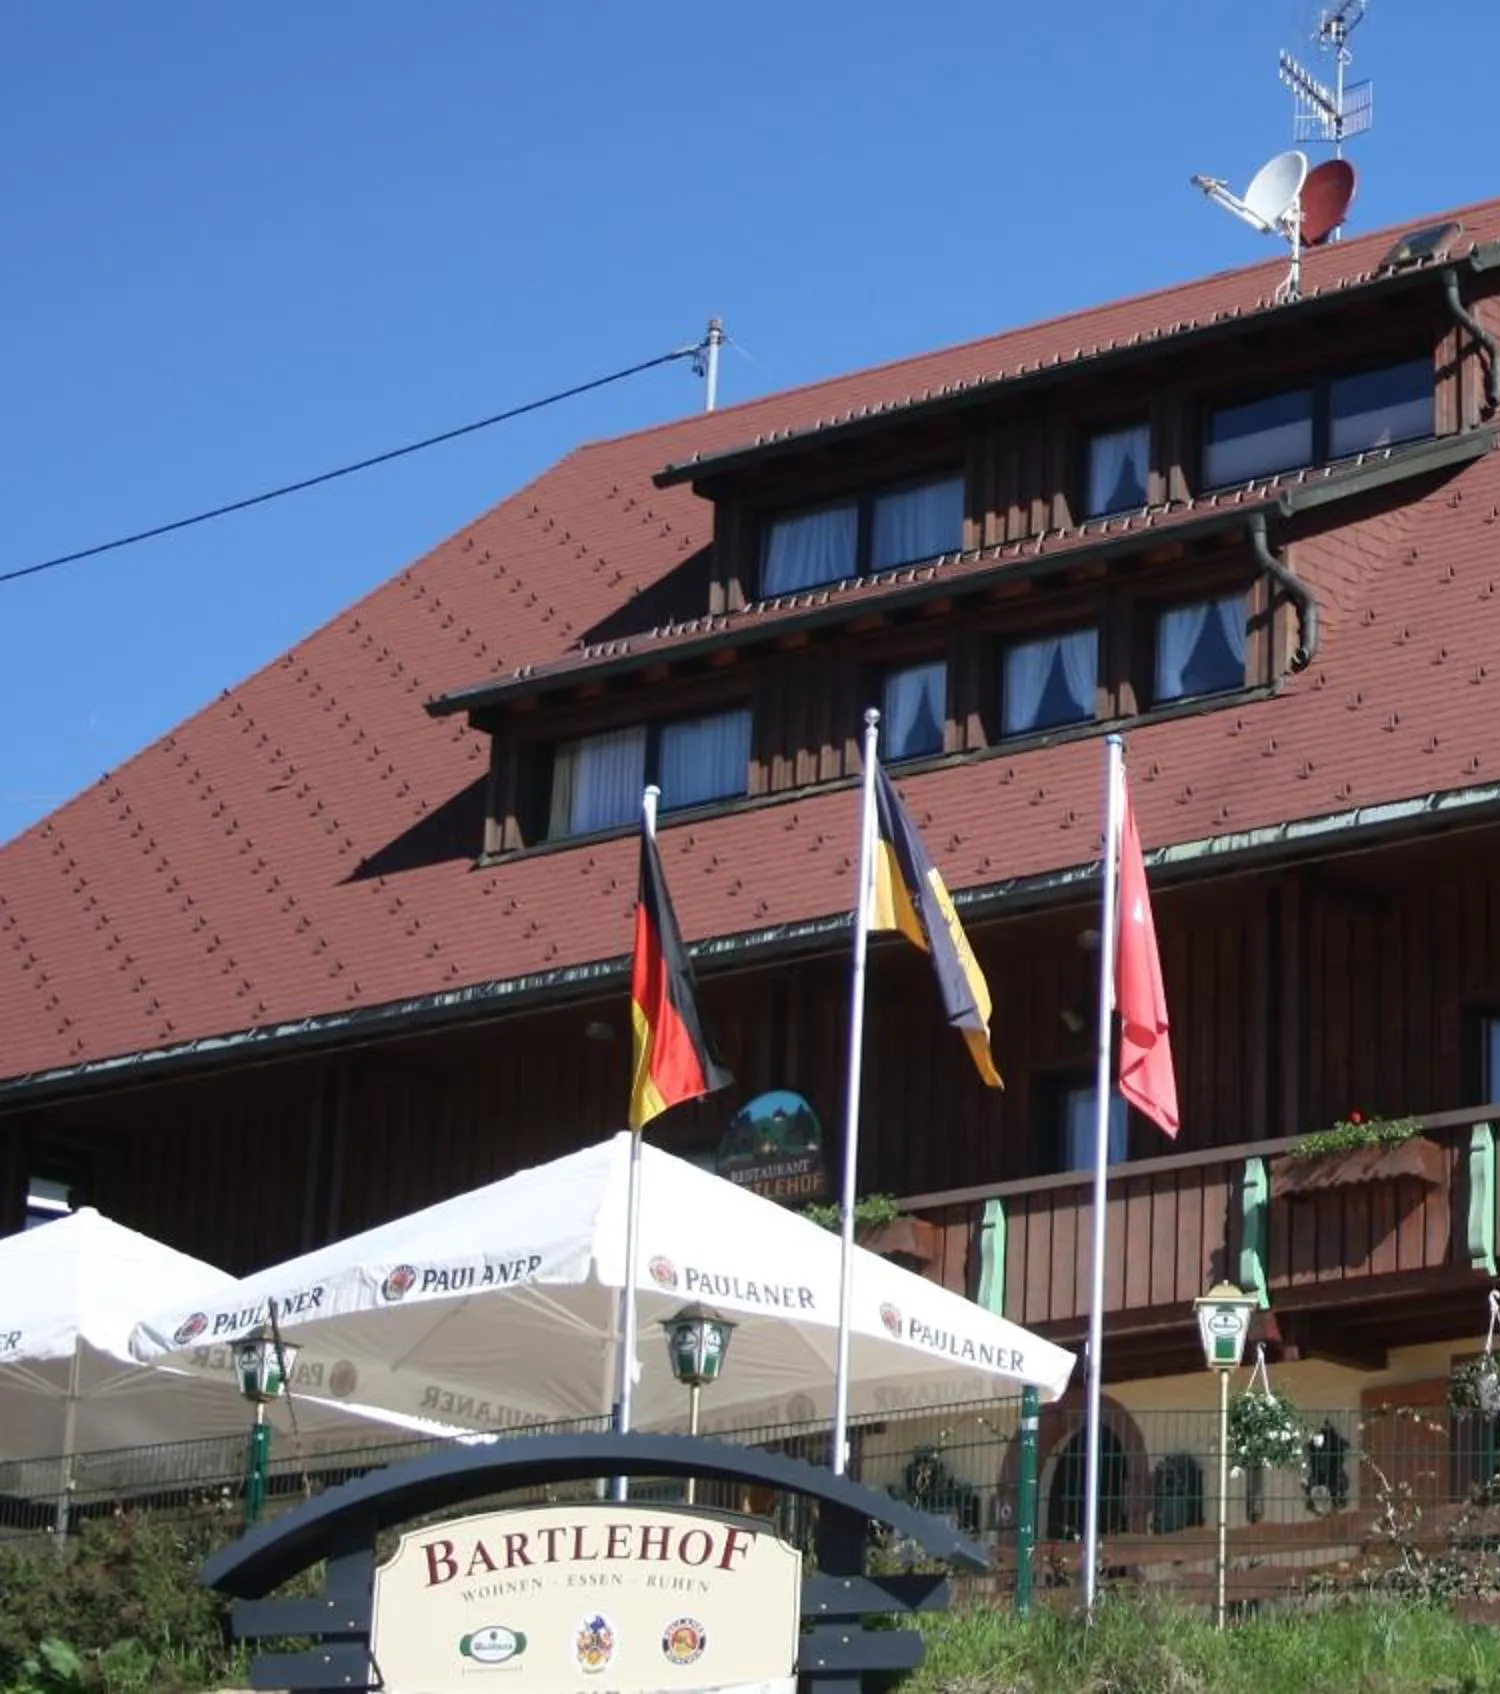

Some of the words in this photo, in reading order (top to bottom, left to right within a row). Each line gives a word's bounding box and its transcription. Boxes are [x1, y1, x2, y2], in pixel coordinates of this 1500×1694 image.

[421, 1254, 542, 1293] PAULANER
[684, 1266, 817, 1310] PAULANER
[212, 1286, 324, 1336] PAULNER
[909, 1317, 1025, 1373] PAULANER
[420, 1523, 758, 1588] BARTLEHOF
[462, 1576, 544, 1602] WOHNEN
[567, 1573, 624, 1587] ESSEN
[647, 1574, 712, 1595] RUHEN
